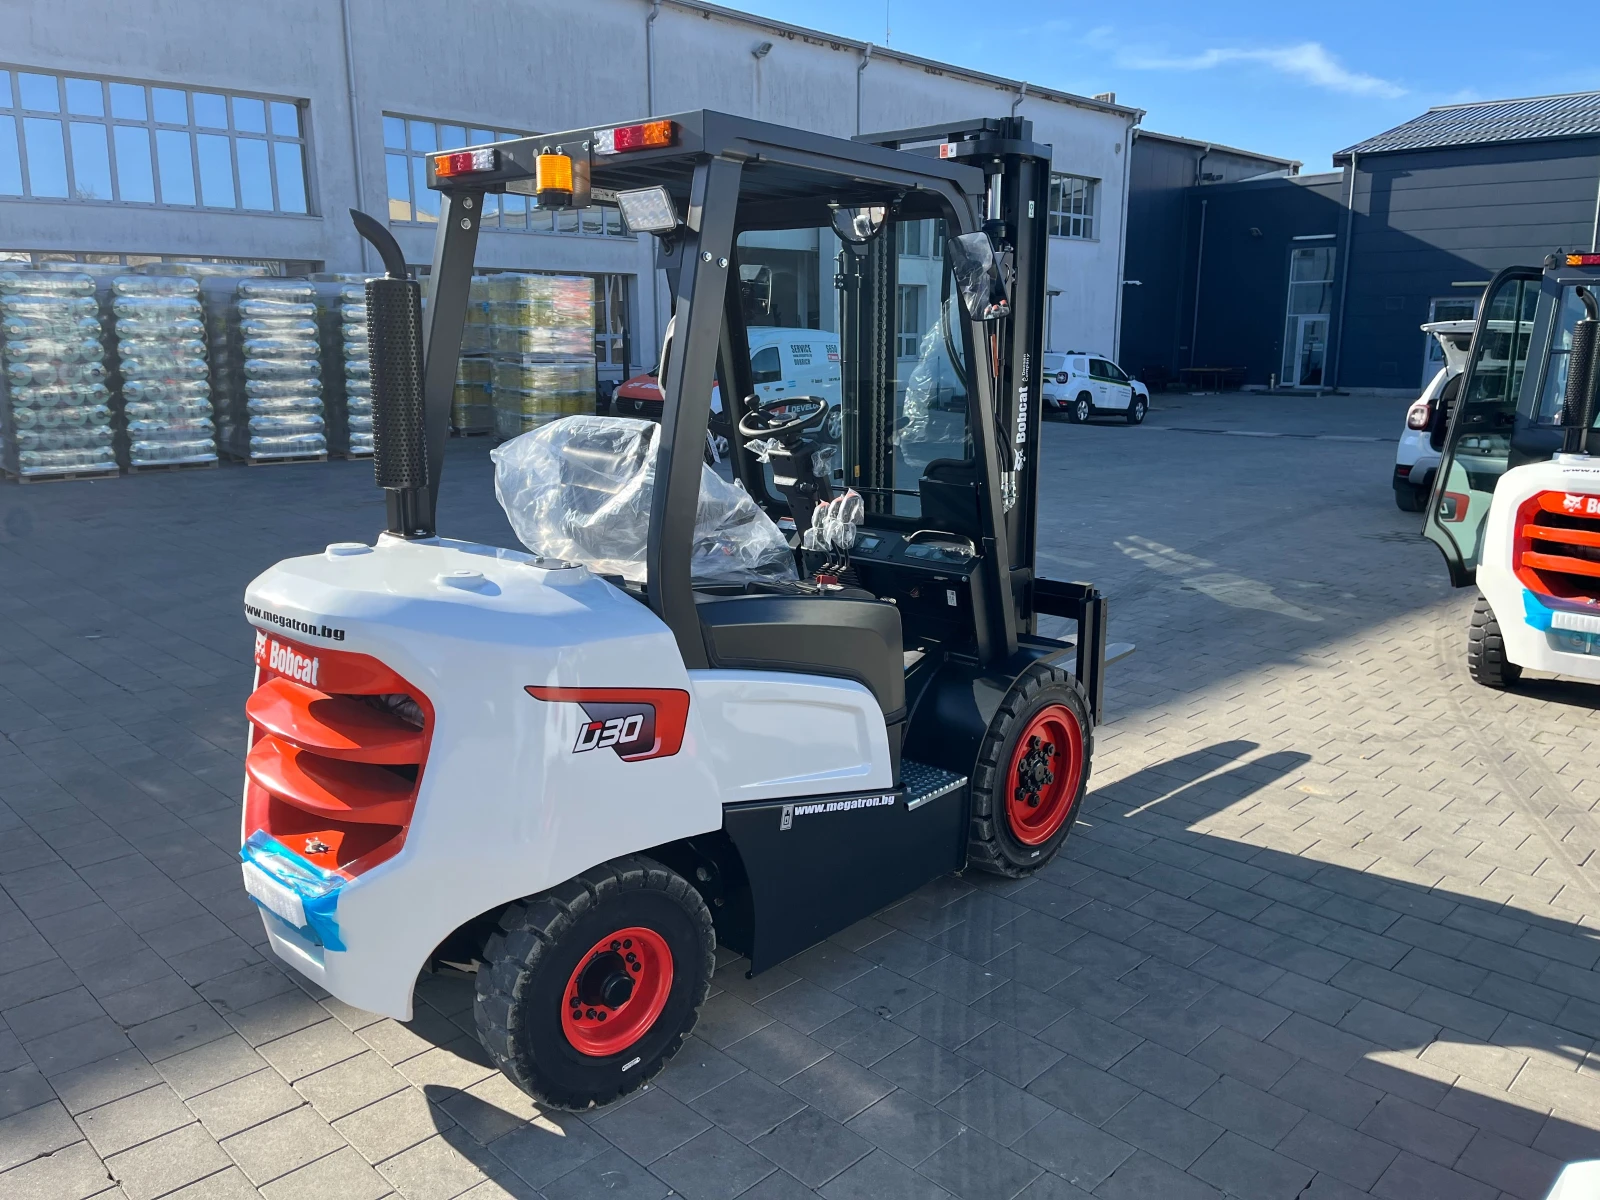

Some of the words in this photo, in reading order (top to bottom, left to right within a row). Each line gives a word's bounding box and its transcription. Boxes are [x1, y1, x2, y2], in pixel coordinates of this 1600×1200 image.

[790, 344, 812, 353] SERVICE
[1016, 386, 1029, 444] Bobcat
[269, 639, 319, 687] Bobcat
[572, 713, 645, 754] D30
[794, 795, 895, 816] www.megatron.bg
